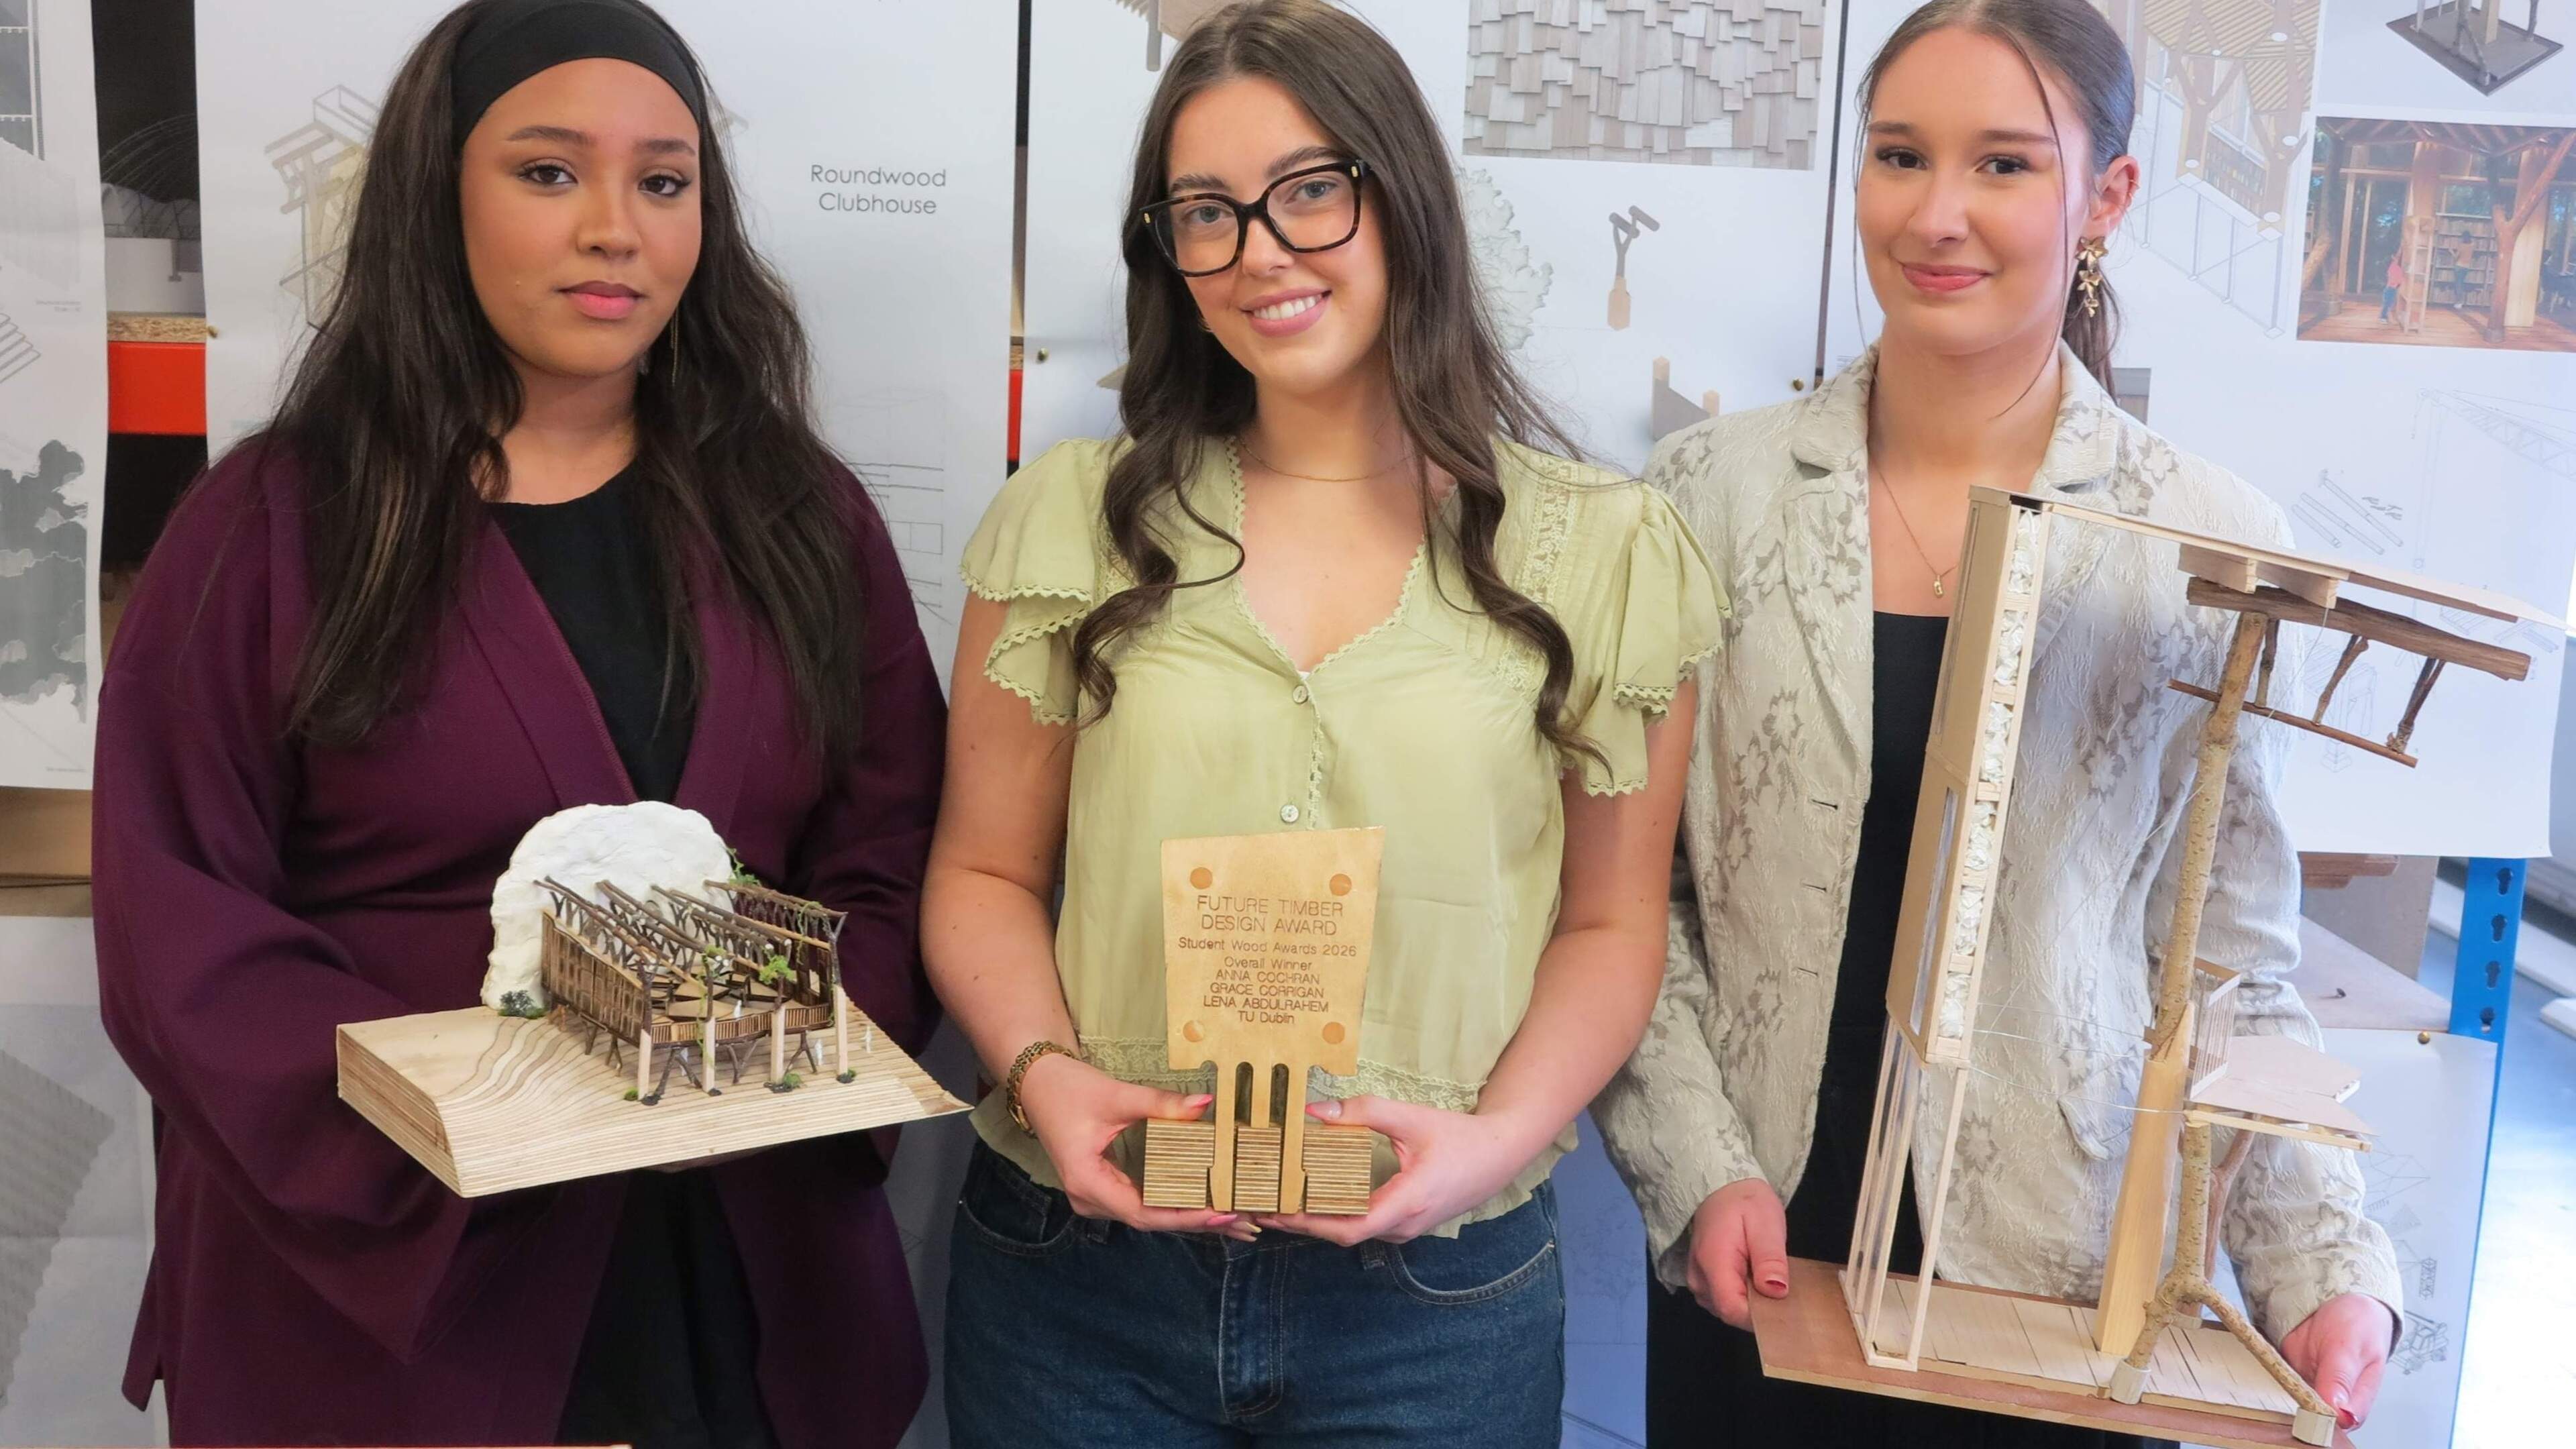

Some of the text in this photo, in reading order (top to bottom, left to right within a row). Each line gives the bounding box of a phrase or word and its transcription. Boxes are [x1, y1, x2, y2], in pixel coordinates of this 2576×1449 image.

[811, 164, 947, 187] Roundwood
[818, 192, 936, 214] Clubhouse
[1197, 895, 1342, 917] FUTURE TIMBER
[1201, 914, 1337, 936] DESIGN AWARD
[1178, 936, 1356, 957] Student Wood Awards 2026
[1224, 956, 1312, 971] Overall Winner
[1215, 969, 1320, 985] ANNA COCHRAN
[1210, 982, 1324, 998] GRACE CORRIGAN
[1203, 996, 1329, 1012] LENA ABDULRAHEM
[1238, 1010, 1295, 1024] TU Dublin
